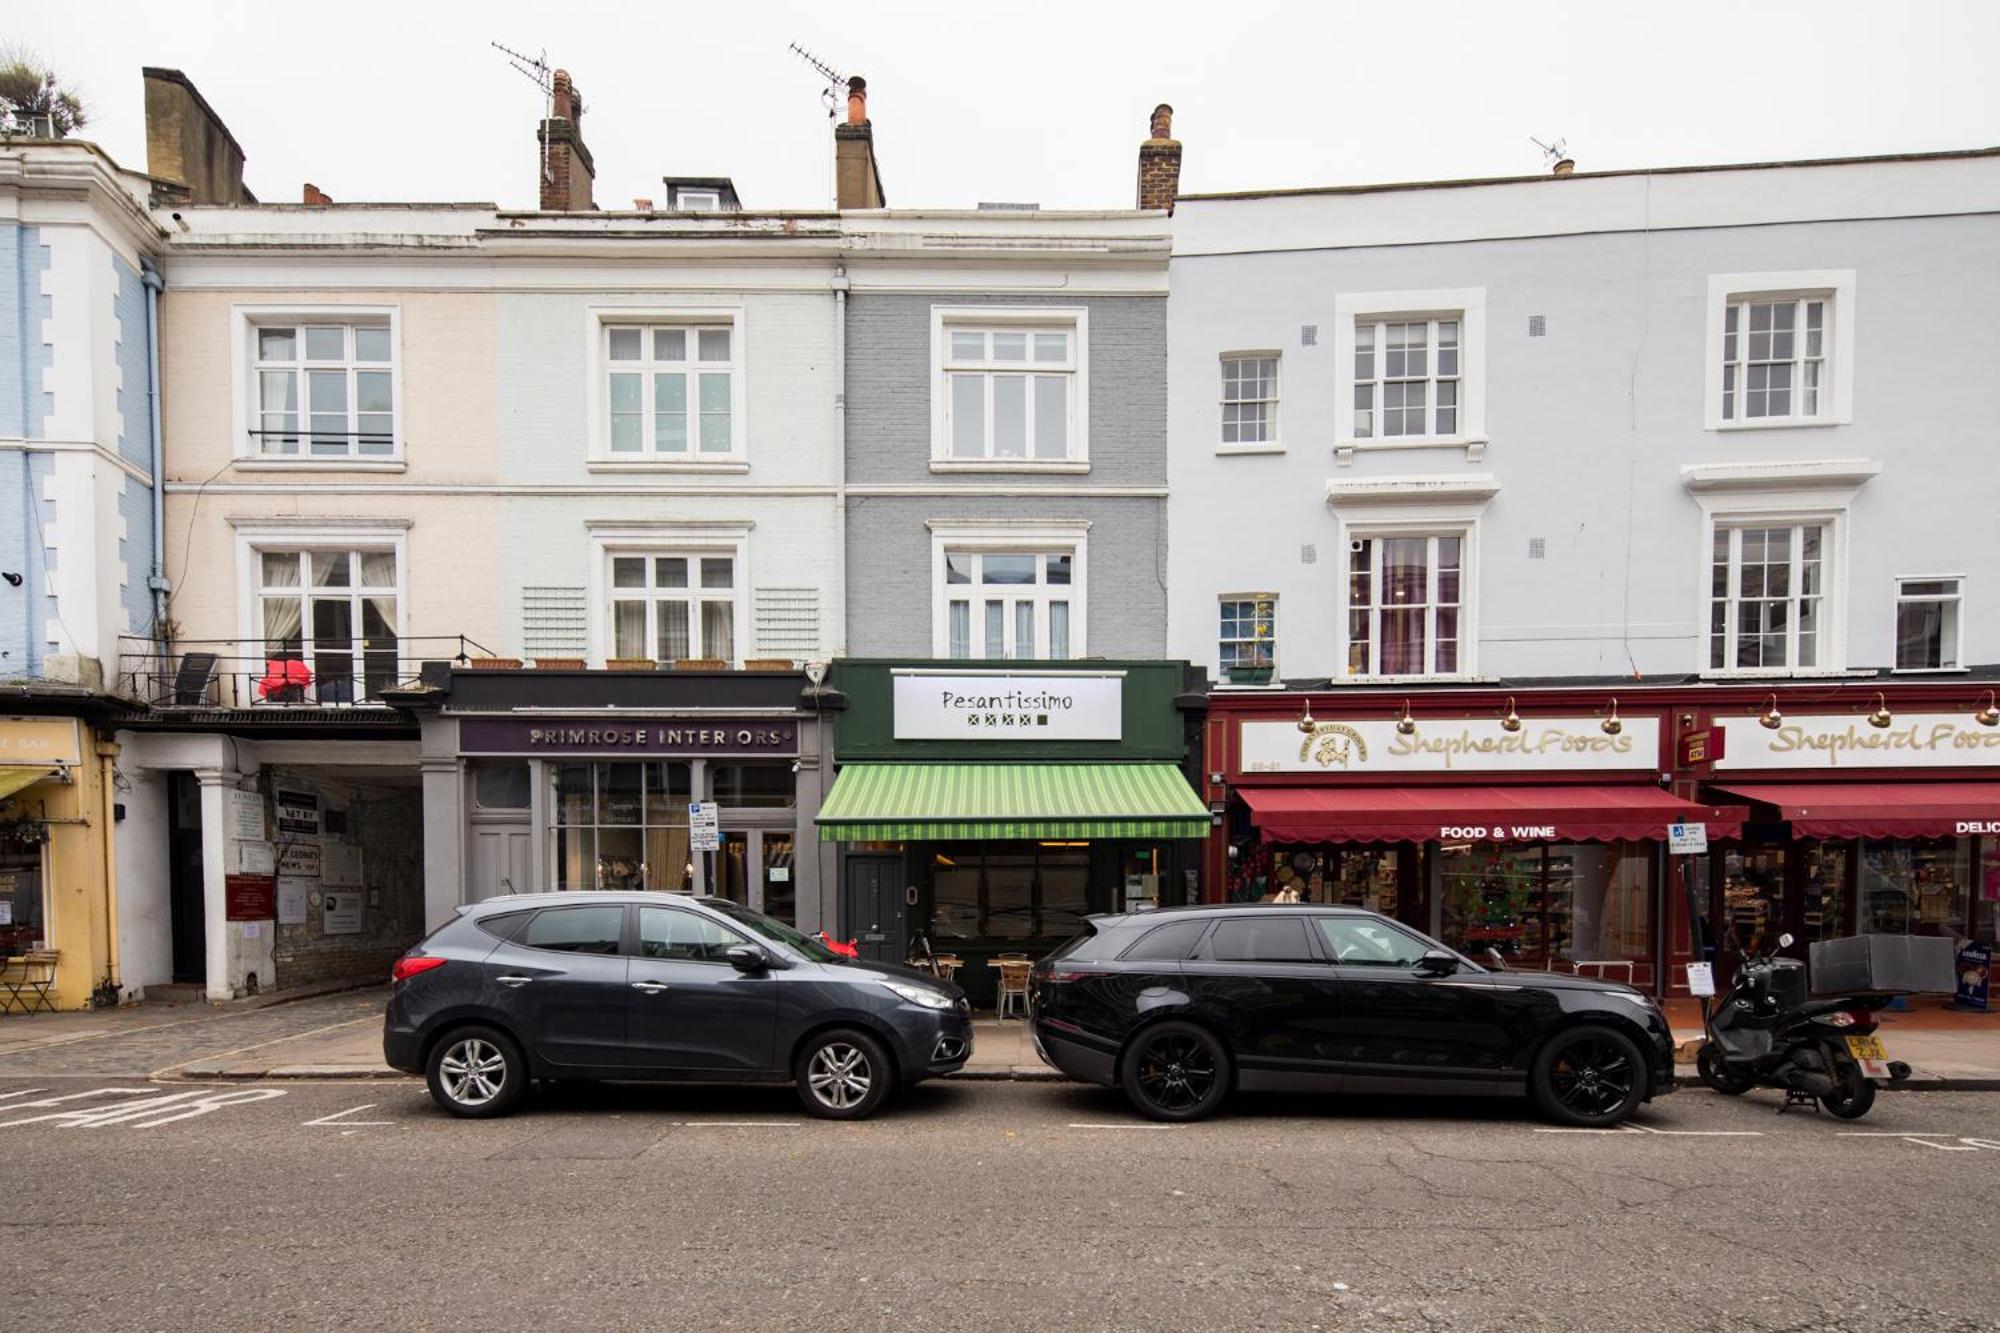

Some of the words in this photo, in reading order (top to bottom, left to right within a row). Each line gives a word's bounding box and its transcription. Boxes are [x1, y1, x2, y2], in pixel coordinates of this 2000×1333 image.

[942, 690, 1073, 710] Pesantissimo
[530, 729, 648, 745] PRIMROSE
[659, 729, 782, 745] INTERIORS
[1768, 724, 1923, 766] Shepherd
[1388, 728, 1534, 769] Shepherd
[1539, 727, 1633, 754] Foods
[1440, 826, 1488, 838] FOOD
[1493, 826, 1505, 838] &
[1511, 826, 1556, 838] WINE
[1955, 821, 2000, 833] DELIC
